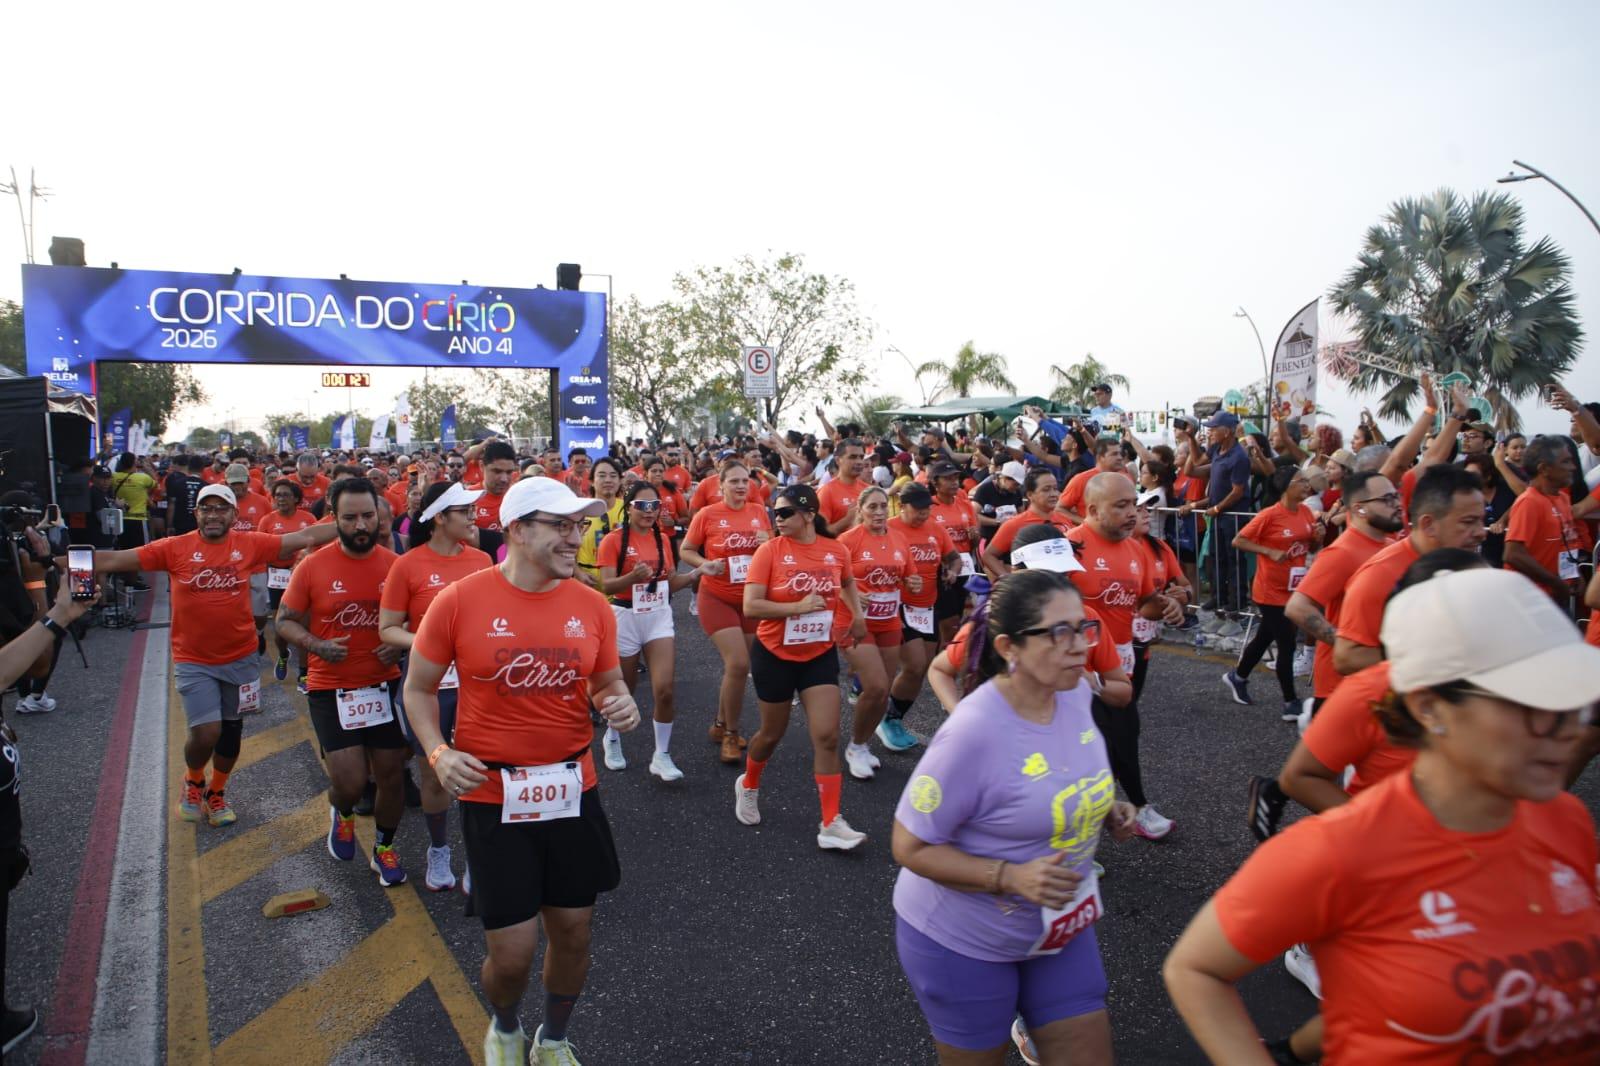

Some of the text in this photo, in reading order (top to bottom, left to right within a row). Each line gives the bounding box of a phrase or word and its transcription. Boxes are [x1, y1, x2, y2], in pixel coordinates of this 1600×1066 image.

[149, 287, 515, 333] CORRIDA DO CÍRIO
[161, 328, 217, 348] 2026
[448, 336, 512, 355] ANO 41
[755, 354, 764, 369] E
[793, 622, 824, 633] 4822
[472, 653, 587, 688] Círio
[348, 701, 383, 717] 5073
[518, 784, 567, 803] 4801
